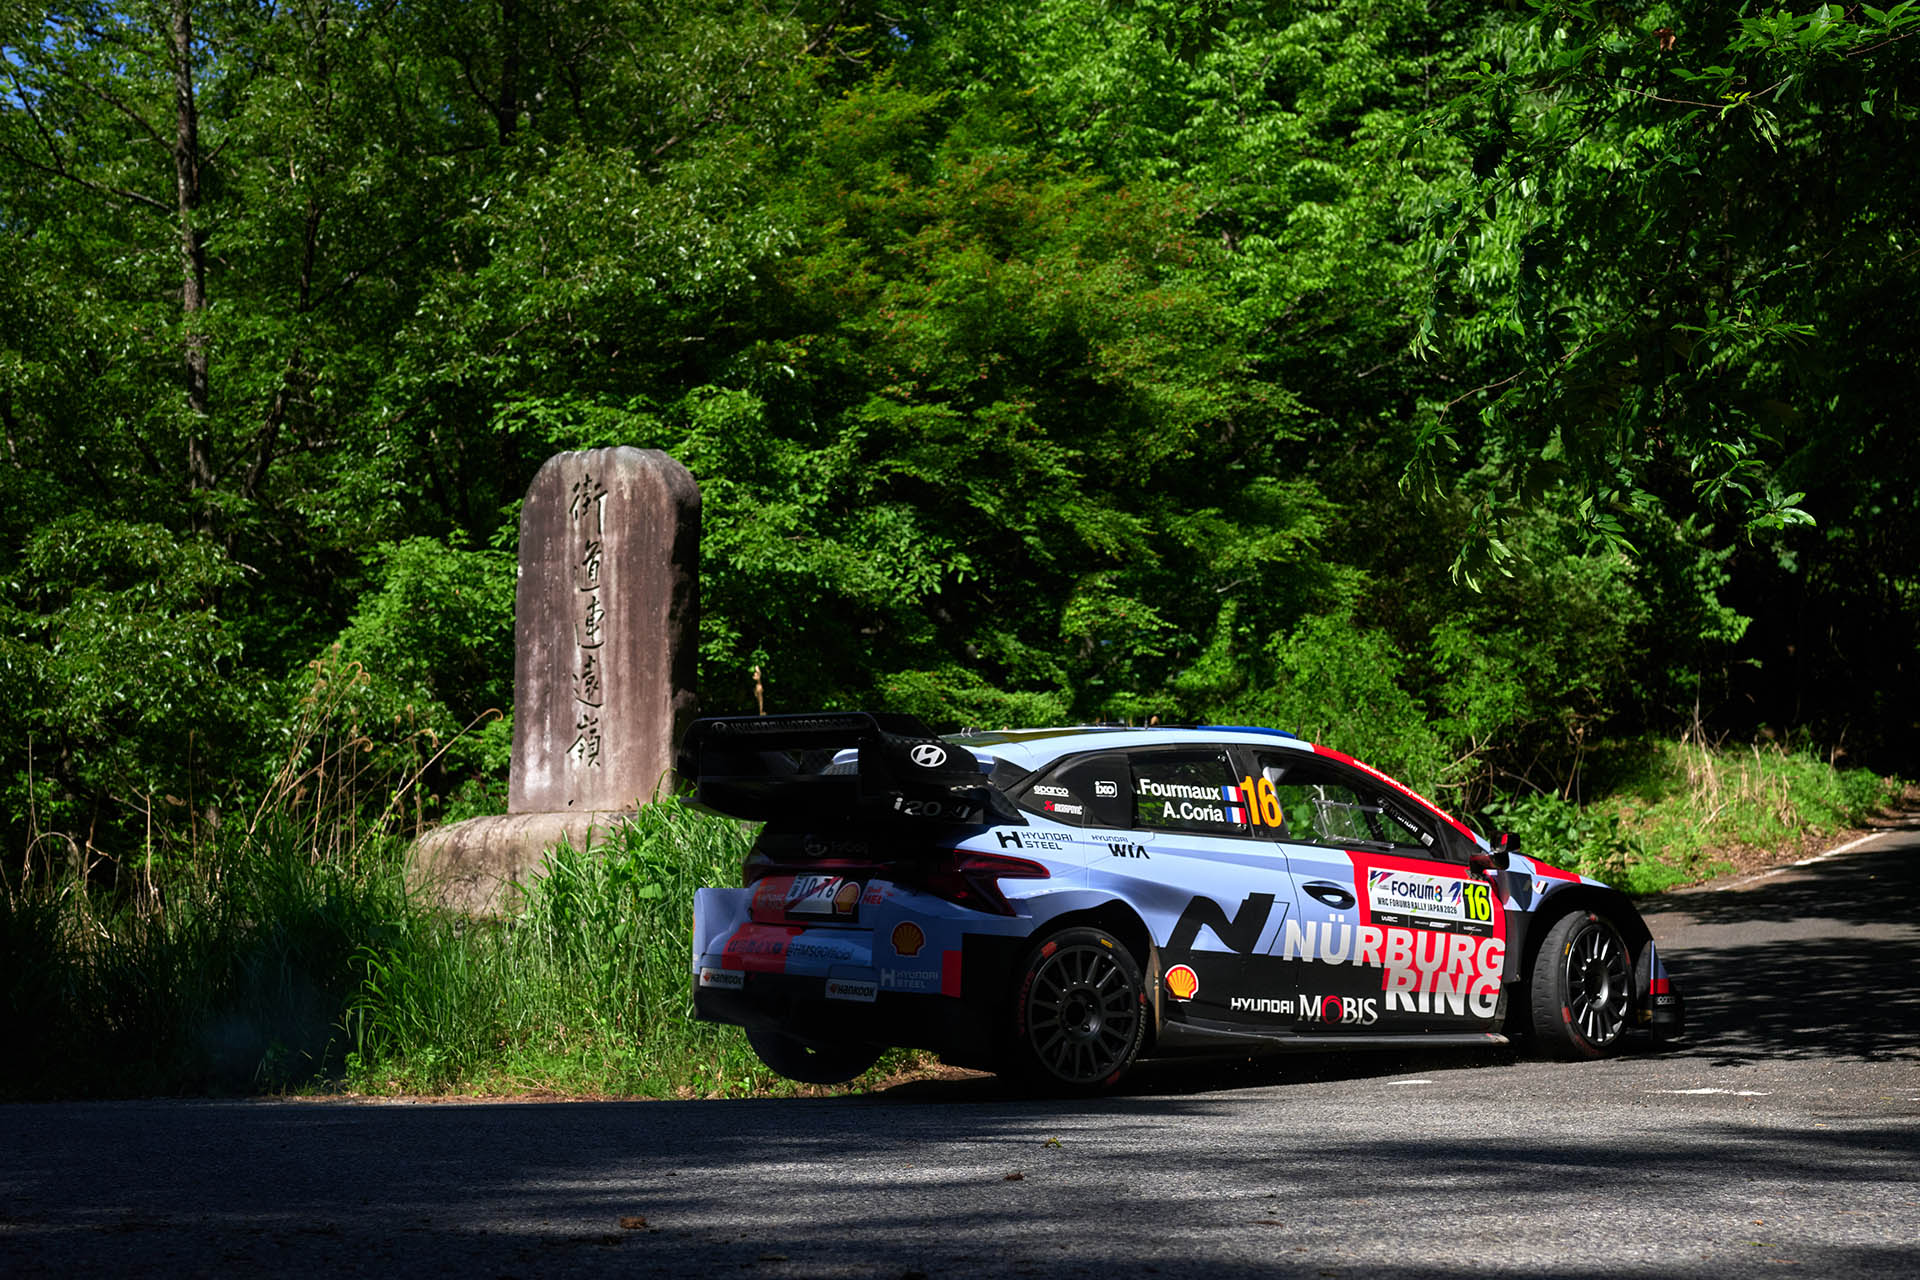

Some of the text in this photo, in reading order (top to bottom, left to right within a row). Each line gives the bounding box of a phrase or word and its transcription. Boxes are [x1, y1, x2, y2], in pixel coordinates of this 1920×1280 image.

[1033, 785, 1069, 797] sparco
[1094, 781, 1115, 795] ixo
[1136, 778, 1221, 800] .Fourmaux
[893, 796, 942, 816] i20
[1163, 801, 1224, 822] A.Coria
[1240, 775, 1283, 828] 16
[1022, 832, 1073, 842] HYUNDAI
[1025, 840, 1063, 850] STEEL
[1091, 834, 1129, 842] HYUNDAI
[1391, 880, 1443, 902] FORUM8
[1377, 897, 1389, 906] WRC
[1389, 898, 1410, 909] FORUM8
[1410, 900, 1427, 911] RALLY
[1427, 903, 1444, 913] JAPAN
[1464, 884, 1490, 921] 16
[1283, 914, 1505, 977] NÜRBURG
[895, 968, 938, 979] HYUNDAI
[896, 978, 926, 989] STEEL
[1385, 967, 1501, 1018] RING
[1230, 993, 1378, 1026] HYUNDAI MOBIS
